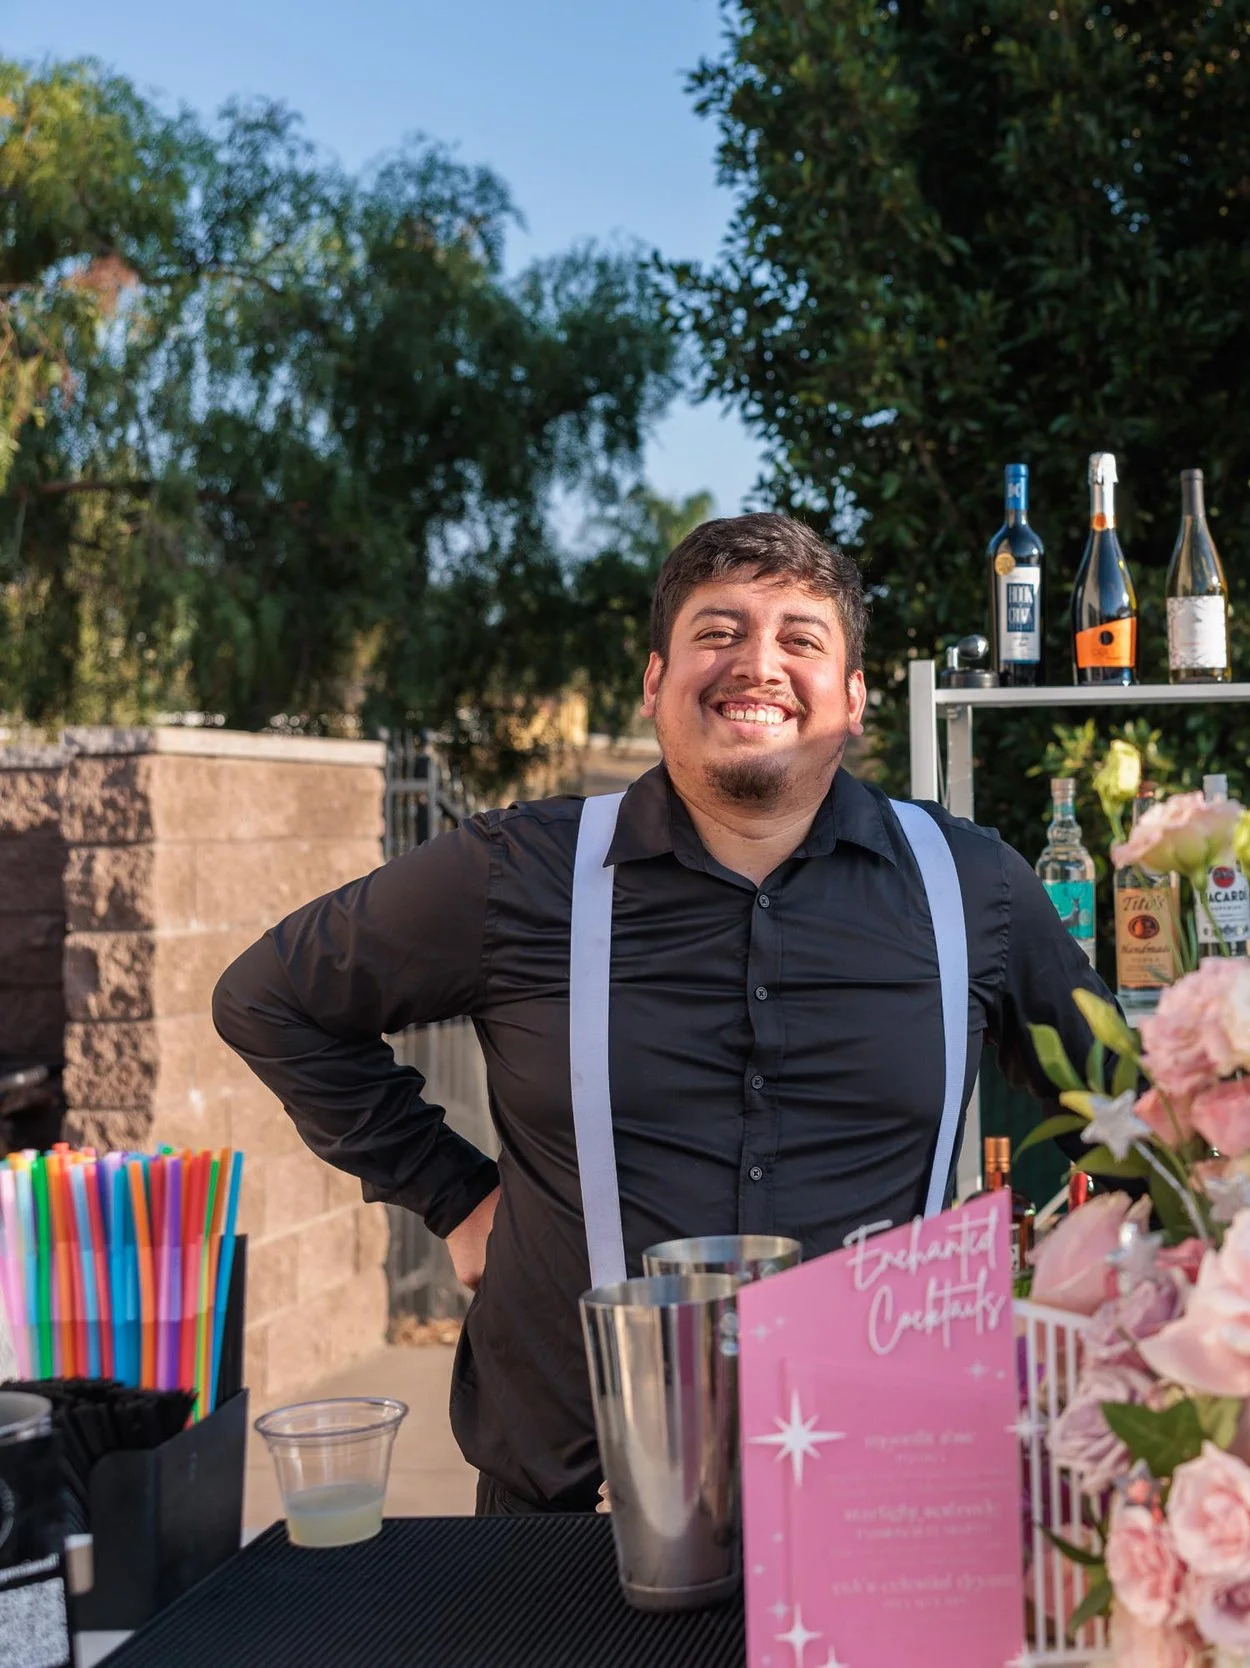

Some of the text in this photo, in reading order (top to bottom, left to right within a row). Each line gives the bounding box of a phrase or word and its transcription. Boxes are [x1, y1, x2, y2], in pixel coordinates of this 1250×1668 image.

[1122, 895, 1165, 911] Tito's
[1206, 890, 1248, 902] ACARDI
[843, 1206, 999, 1292] Enchanted
[868, 1266, 1007, 1356] Cocktails
